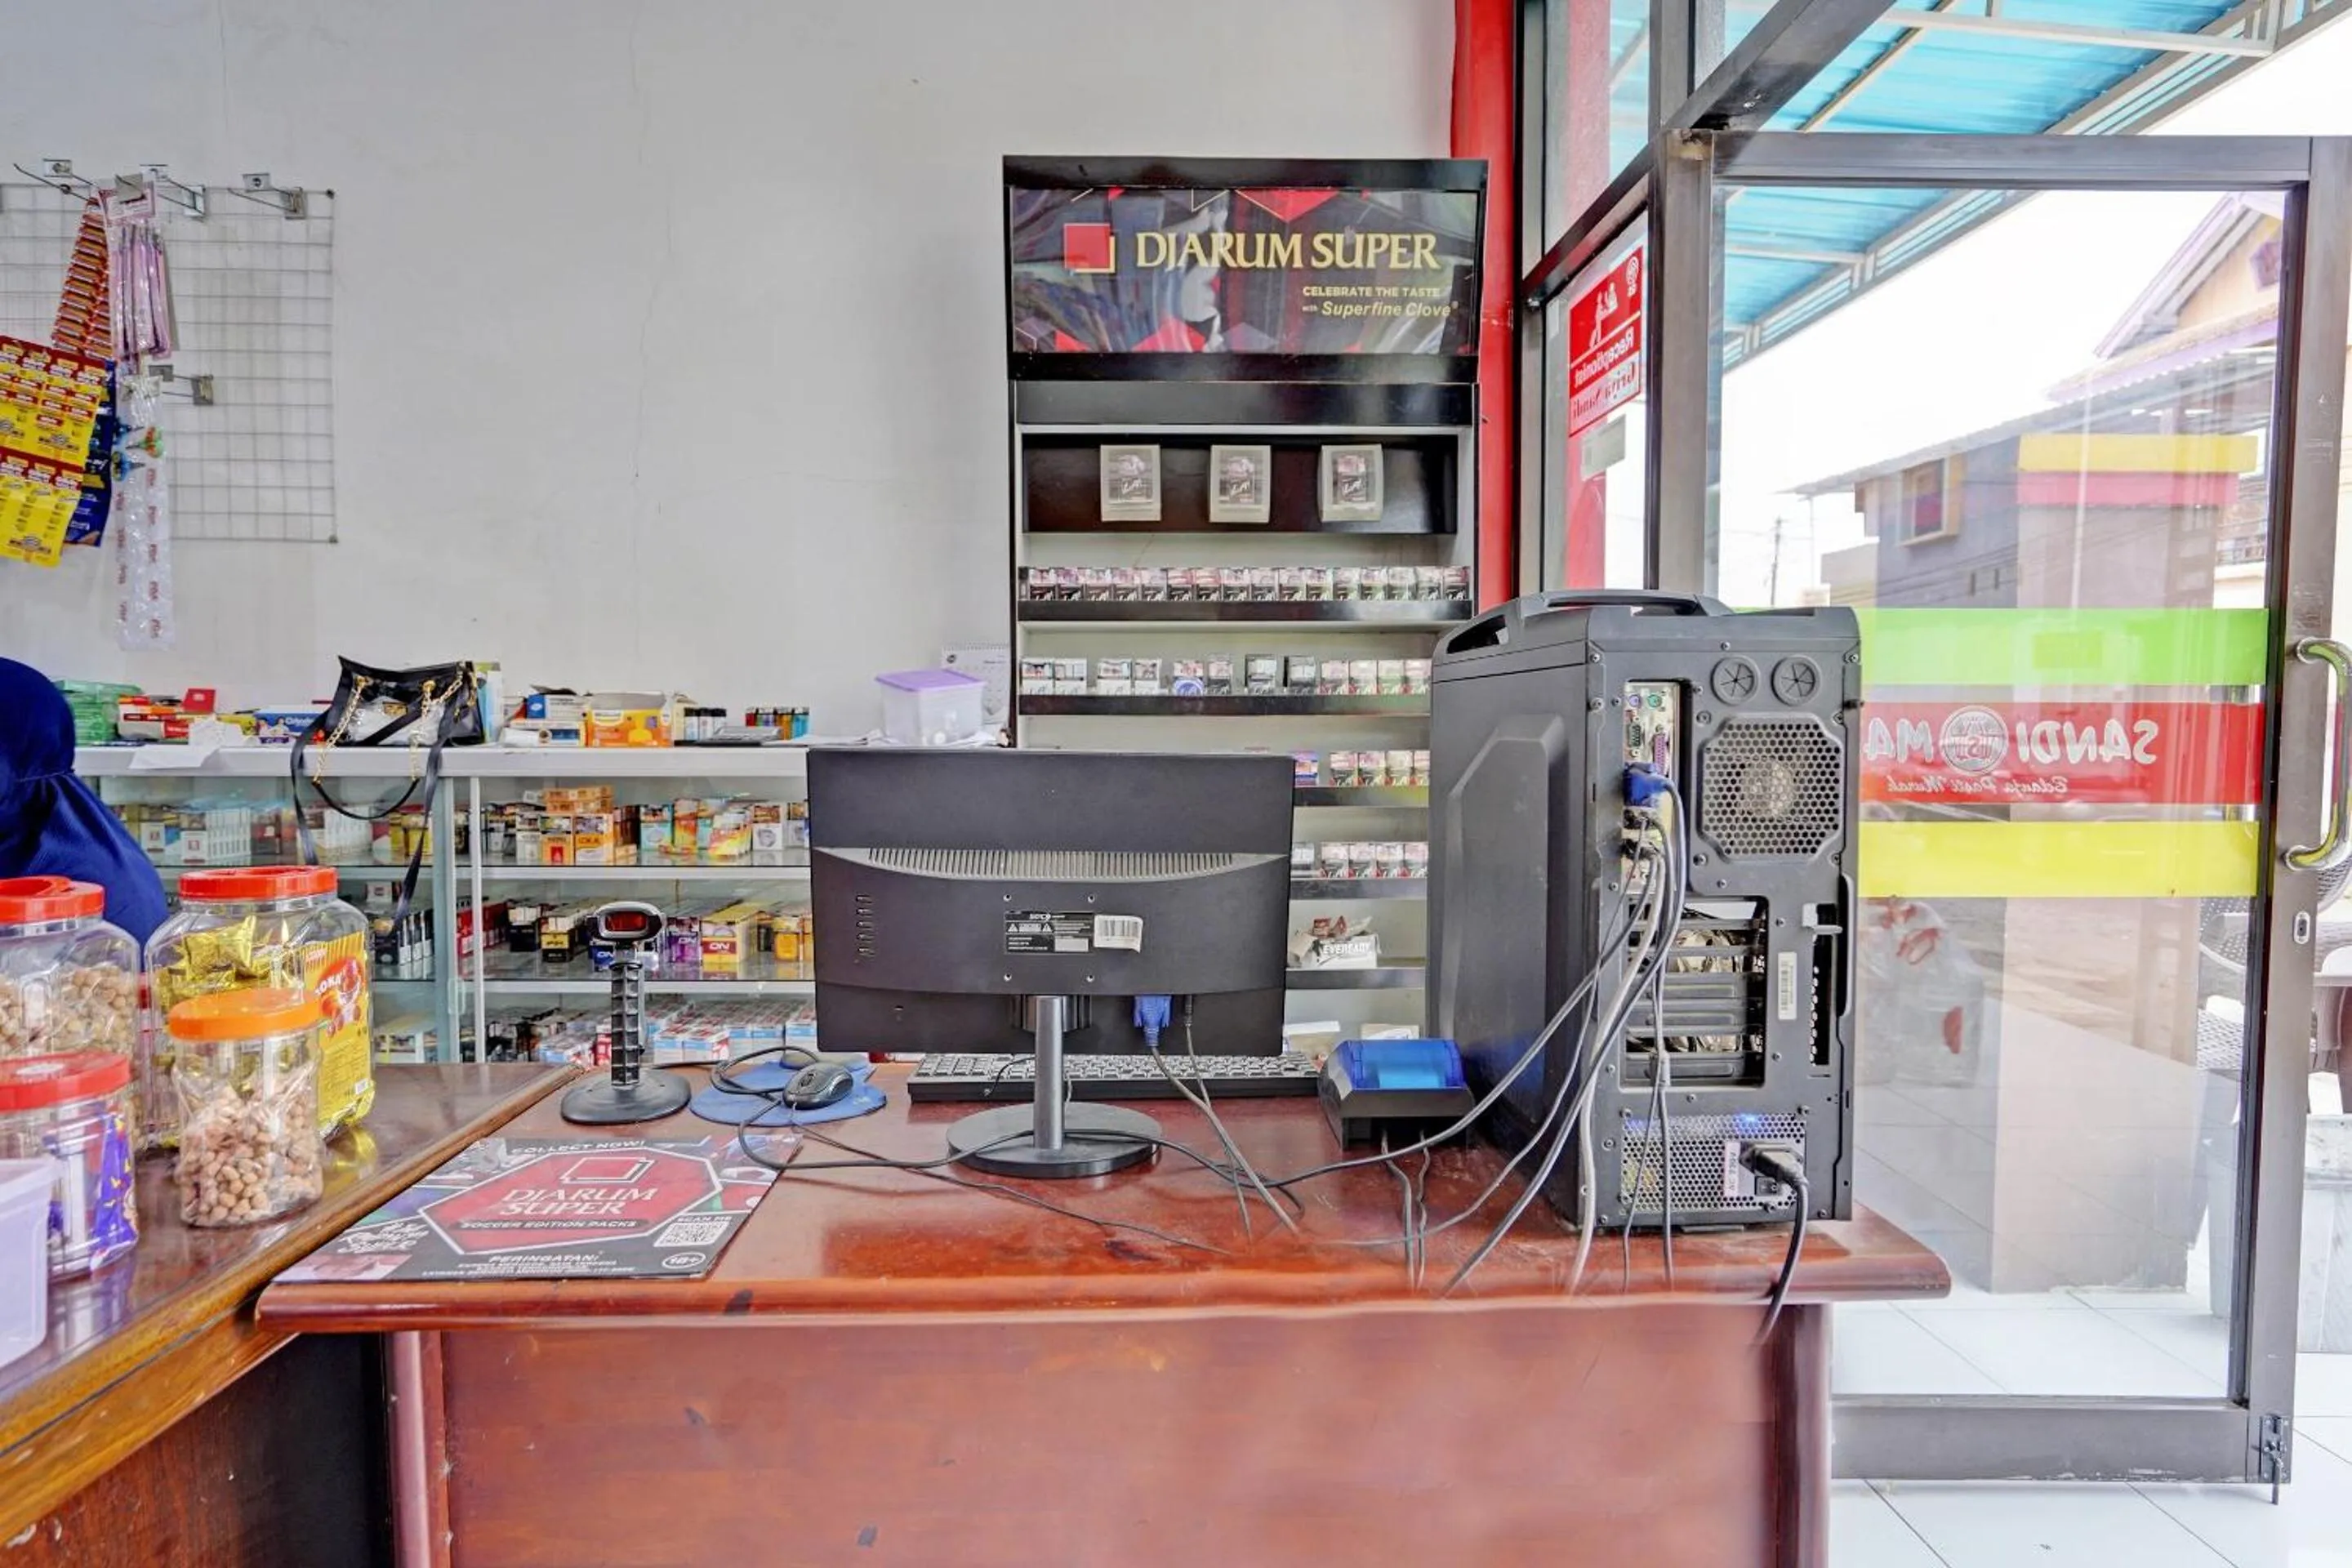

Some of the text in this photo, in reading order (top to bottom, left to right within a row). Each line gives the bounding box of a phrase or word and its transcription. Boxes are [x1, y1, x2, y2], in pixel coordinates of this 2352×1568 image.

[1136, 232, 1441, 271] DJARUM SUPER
[1303, 286, 1442, 297] CELEBRATE THE TASTE
[1321, 301, 1402, 319] Superfine
[511, 1140, 646, 1154] COLLECT NOW!
[500, 1188, 658, 1215] DJARUM SUPER
[460, 1220, 637, 1229] SOCCER EDITION PACKS
